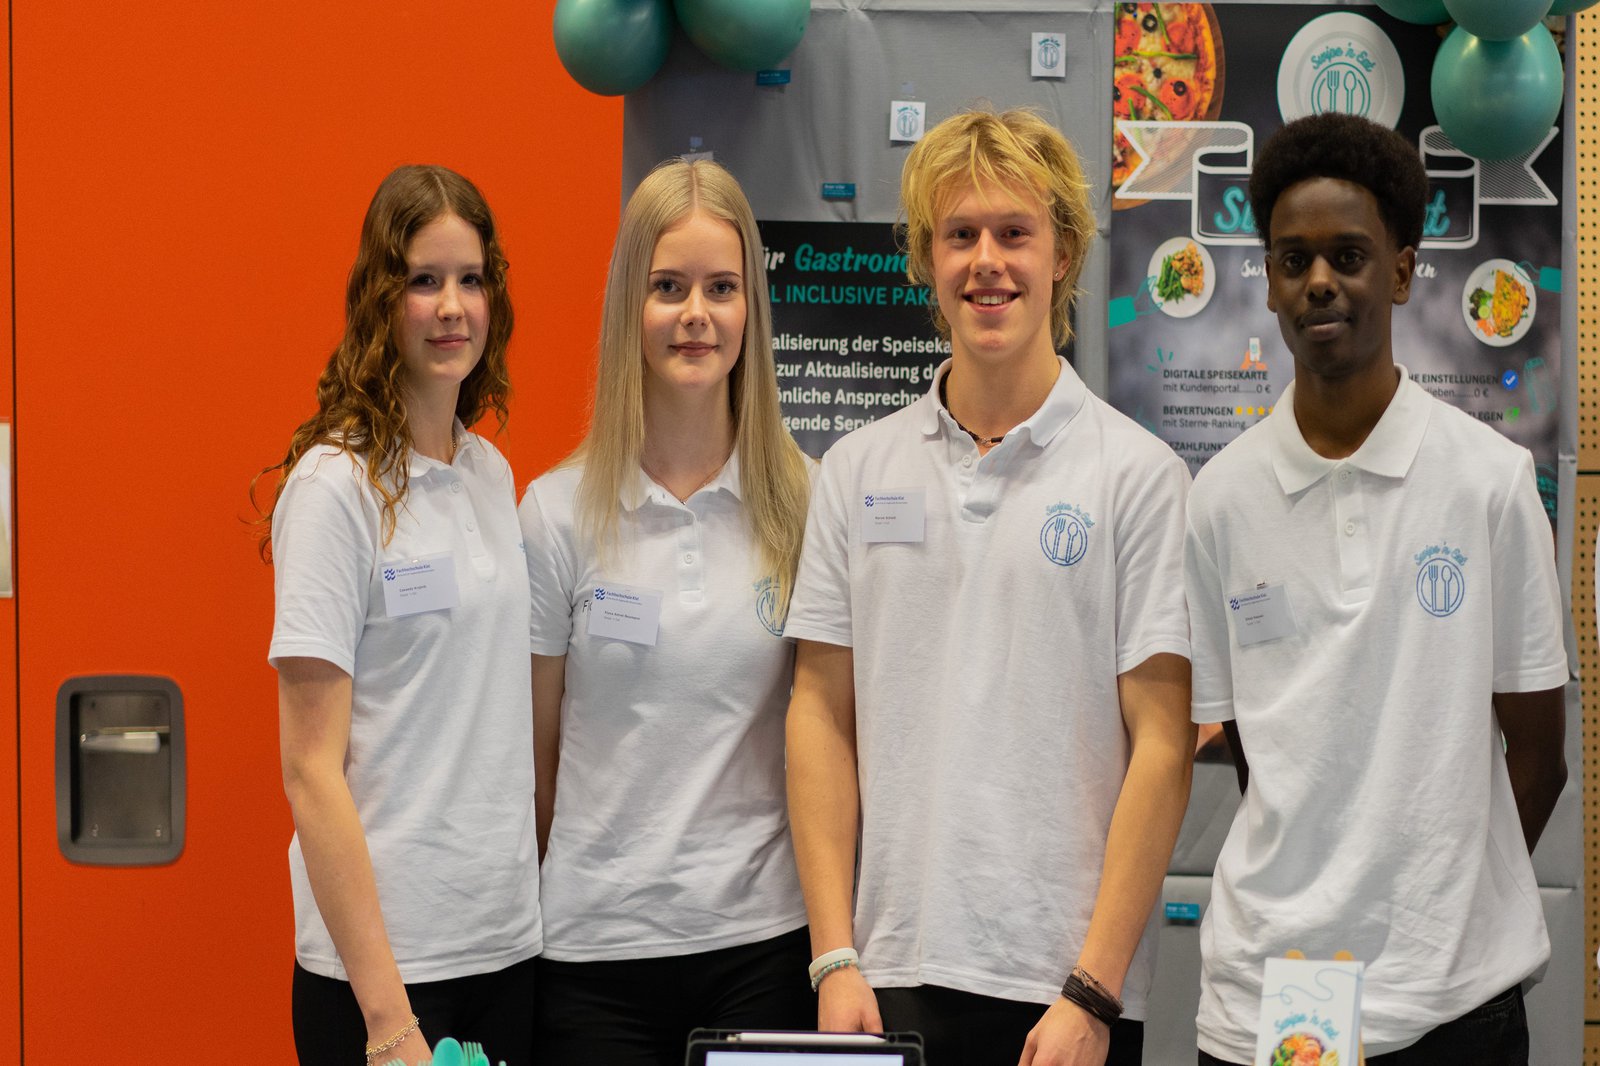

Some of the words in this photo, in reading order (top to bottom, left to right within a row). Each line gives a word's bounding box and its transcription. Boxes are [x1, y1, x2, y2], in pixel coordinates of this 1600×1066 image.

[1311, 46, 1343, 70] Swipe
[1356, 50, 1376, 72] Eat
[786, 285, 887, 305] INCLUSIVE
[772, 333, 849, 356] alisierung
[851, 335, 879, 353] der
[882, 336, 953, 357] Speiseka
[776, 363, 802, 377] zur
[804, 361, 920, 384] Aktualisierung
[1163, 369, 1206, 380] DIGITALE
[1207, 370, 1268, 380] SPEISEKARTE
[1422, 374, 1498, 385] EINSTELLUNGEN
[777, 387, 831, 404] önliche
[1163, 384, 1178, 393] mit
[1163, 405, 1233, 416] BEWERTUNGEN
[783, 414, 831, 432] gende
[1163, 419, 1178, 428] mit
